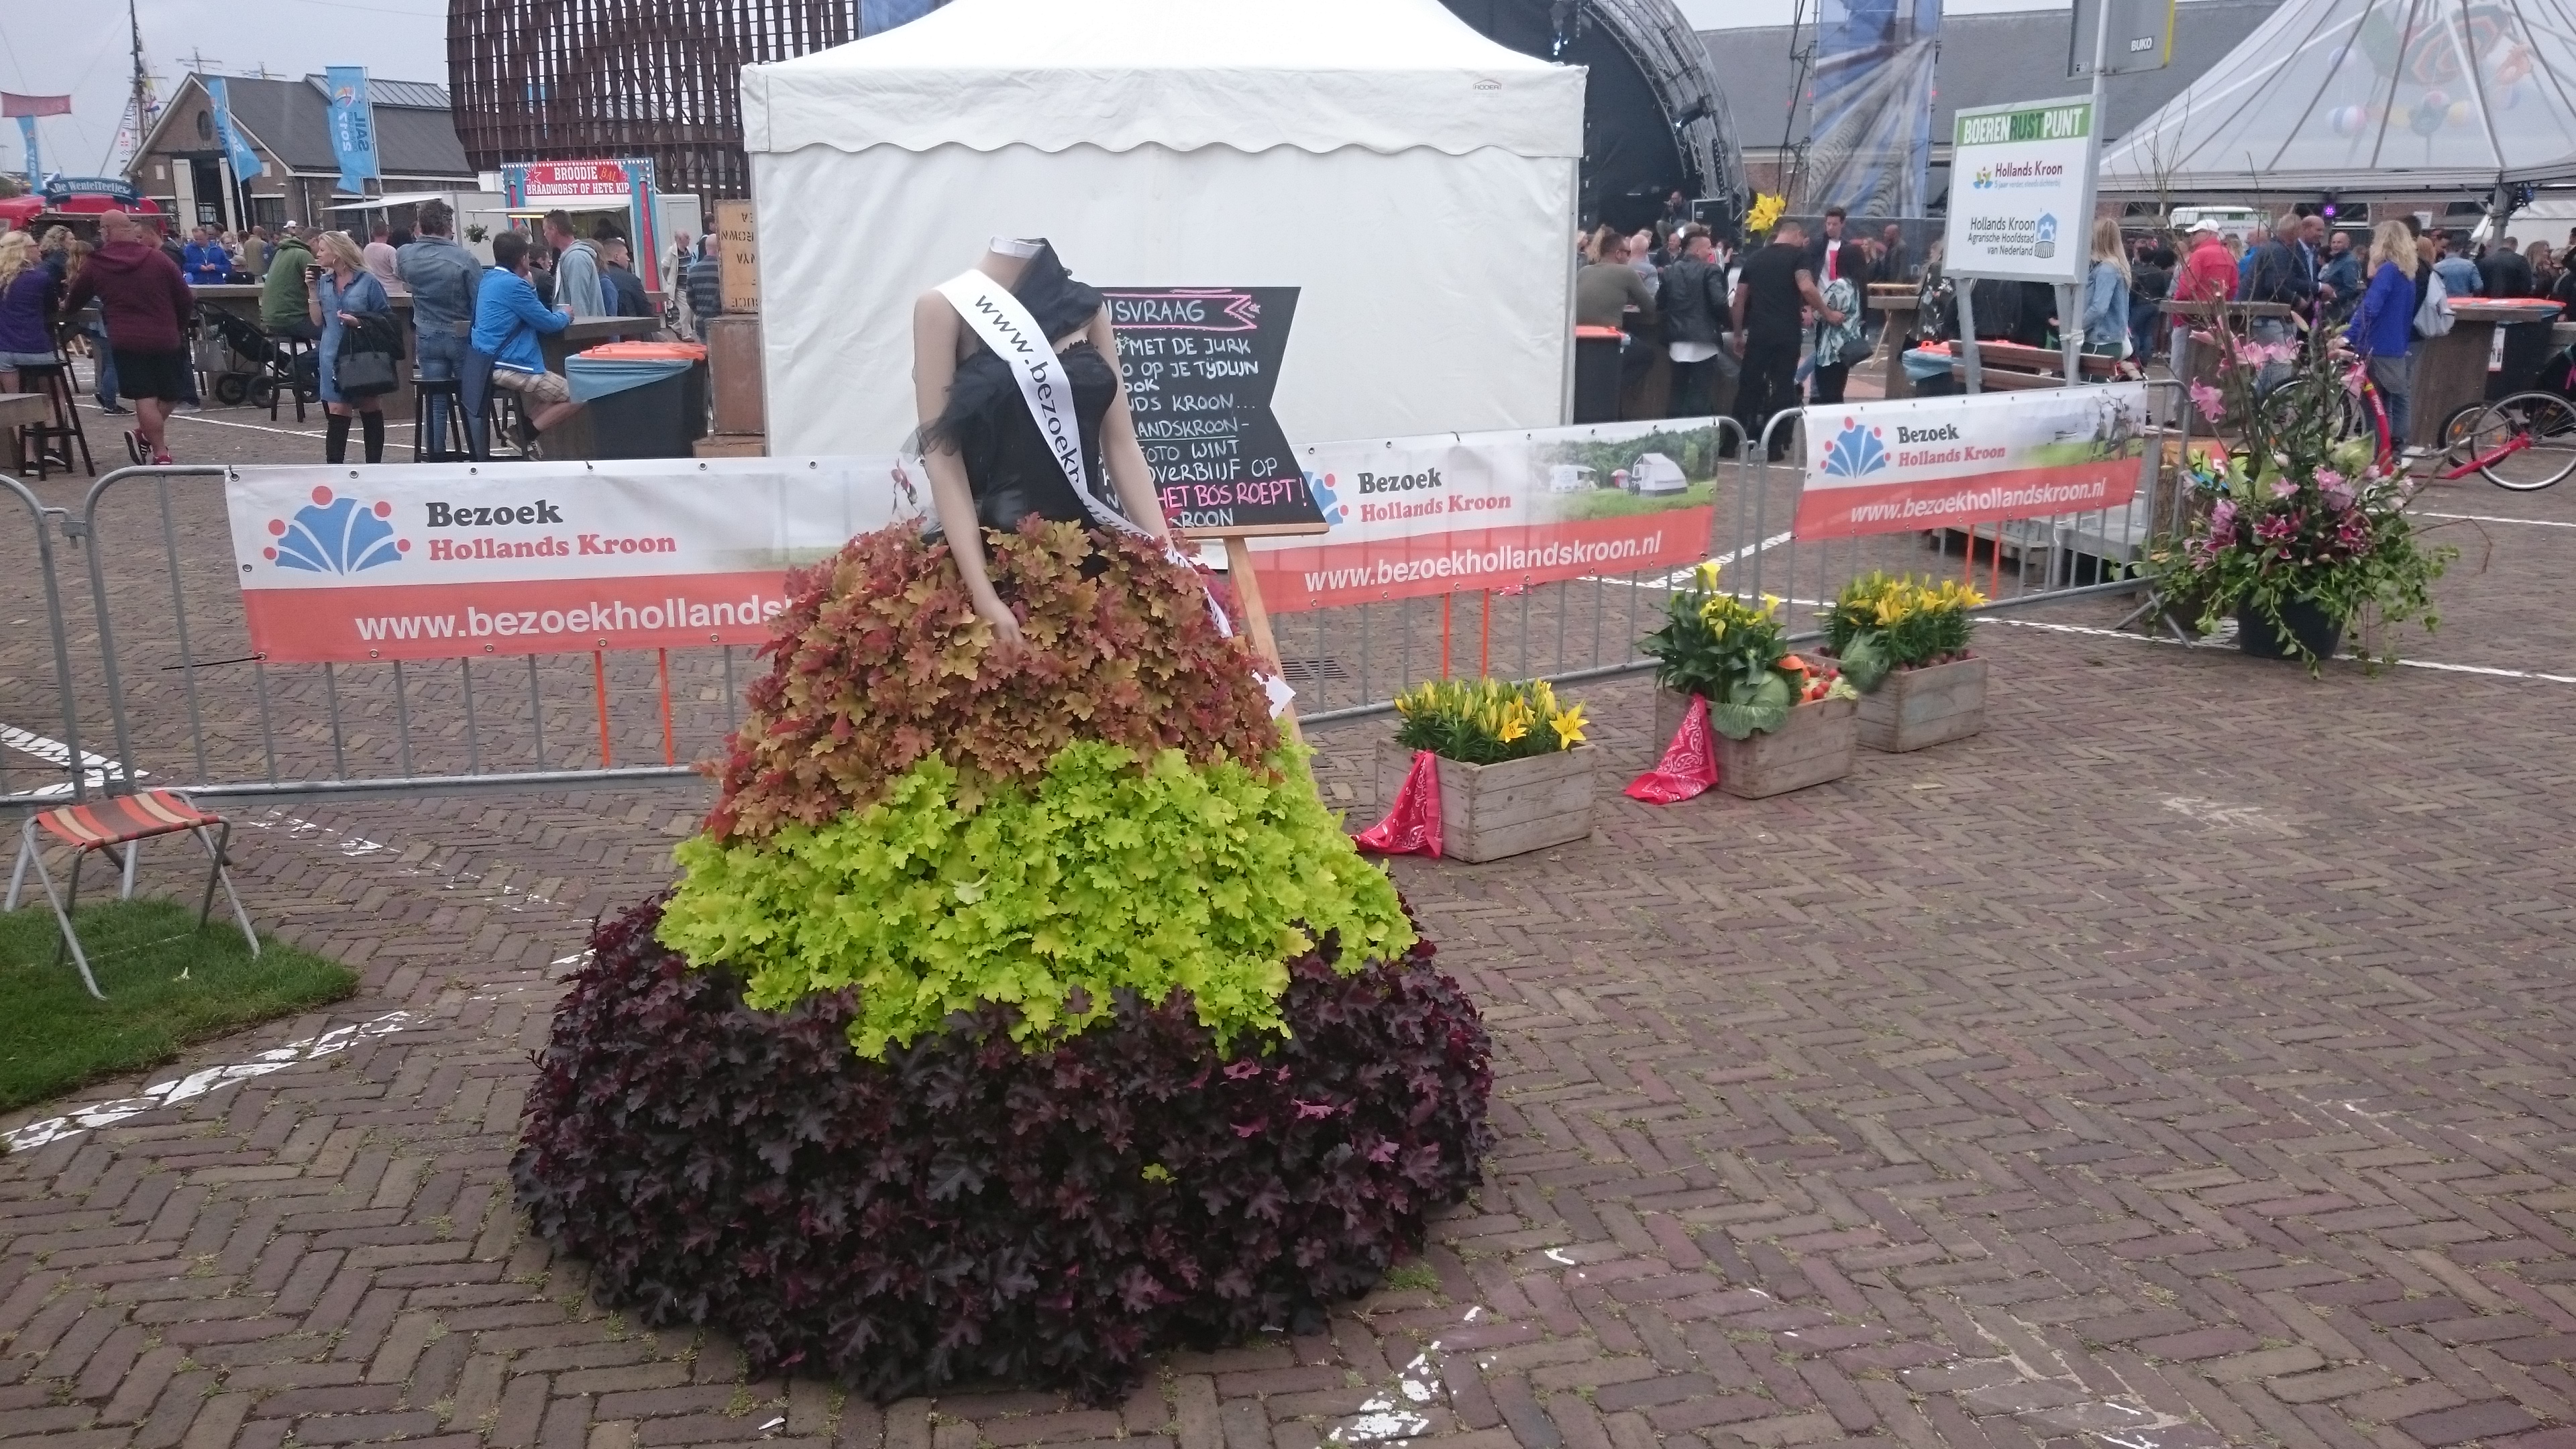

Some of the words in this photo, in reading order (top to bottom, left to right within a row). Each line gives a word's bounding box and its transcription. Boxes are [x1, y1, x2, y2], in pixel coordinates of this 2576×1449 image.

[2131, 37, 2152, 52] BUKO
[1964, 108, 2083, 144] BOERENRUSTPUNT
[554, 166, 598, 181] BROODJE
[600, 167, 616, 182] BAL
[1995, 162, 2032, 178] Hollands
[2035, 160, 2062, 176] Kroon
[54, 182, 66, 193] De
[527, 183, 578, 195] BRAADWORST
[580, 183, 590, 194] OF
[592, 182, 614, 194] HETE
[616, 182, 629, 193] KIP
[1971, 217, 2006, 231] Hollands
[2008, 217, 2035, 231] Kroon
[1968, 233, 2000, 244] Agrarische
[2002, 233, 2034, 244] Hoofdstad
[1987, 247, 1998, 255] van
[2000, 245, 2033, 256] Nederland
[1129, 337, 1166, 356] MET
[1172, 337, 1197, 356] DE
[1203, 338, 1251, 355] JURK
[1141, 362, 1164, 380] OP
[1170, 362, 1191, 378] JE
[1896, 424, 1960, 444] Bezoek
[1191, 439, 1239, 459] WINT
[1898, 447, 1960, 467] Hollands
[1964, 444, 2006, 462] Kroon
[1251, 458, 1277, 477] OP
[2213, 459, 2225, 476] 5
[1358, 467, 1442, 494] Bezoek
[1159, 486, 1190, 508] HET
[1194, 484, 1233, 507] BOS
[1851, 477, 2105, 523] www.bezoekhollandskroon.nl
[425, 499, 564, 528] Bezoek
[1360, 496, 1443, 523] Hollands
[1448, 492, 1511, 512] Kroon
[429, 537, 569, 561] Hollands
[578, 533, 677, 556] Kroon
[1305, 531, 1662, 592] www.bezoekhollandskroon.nl
[356, 594, 792, 641] www.bezoekhollands
